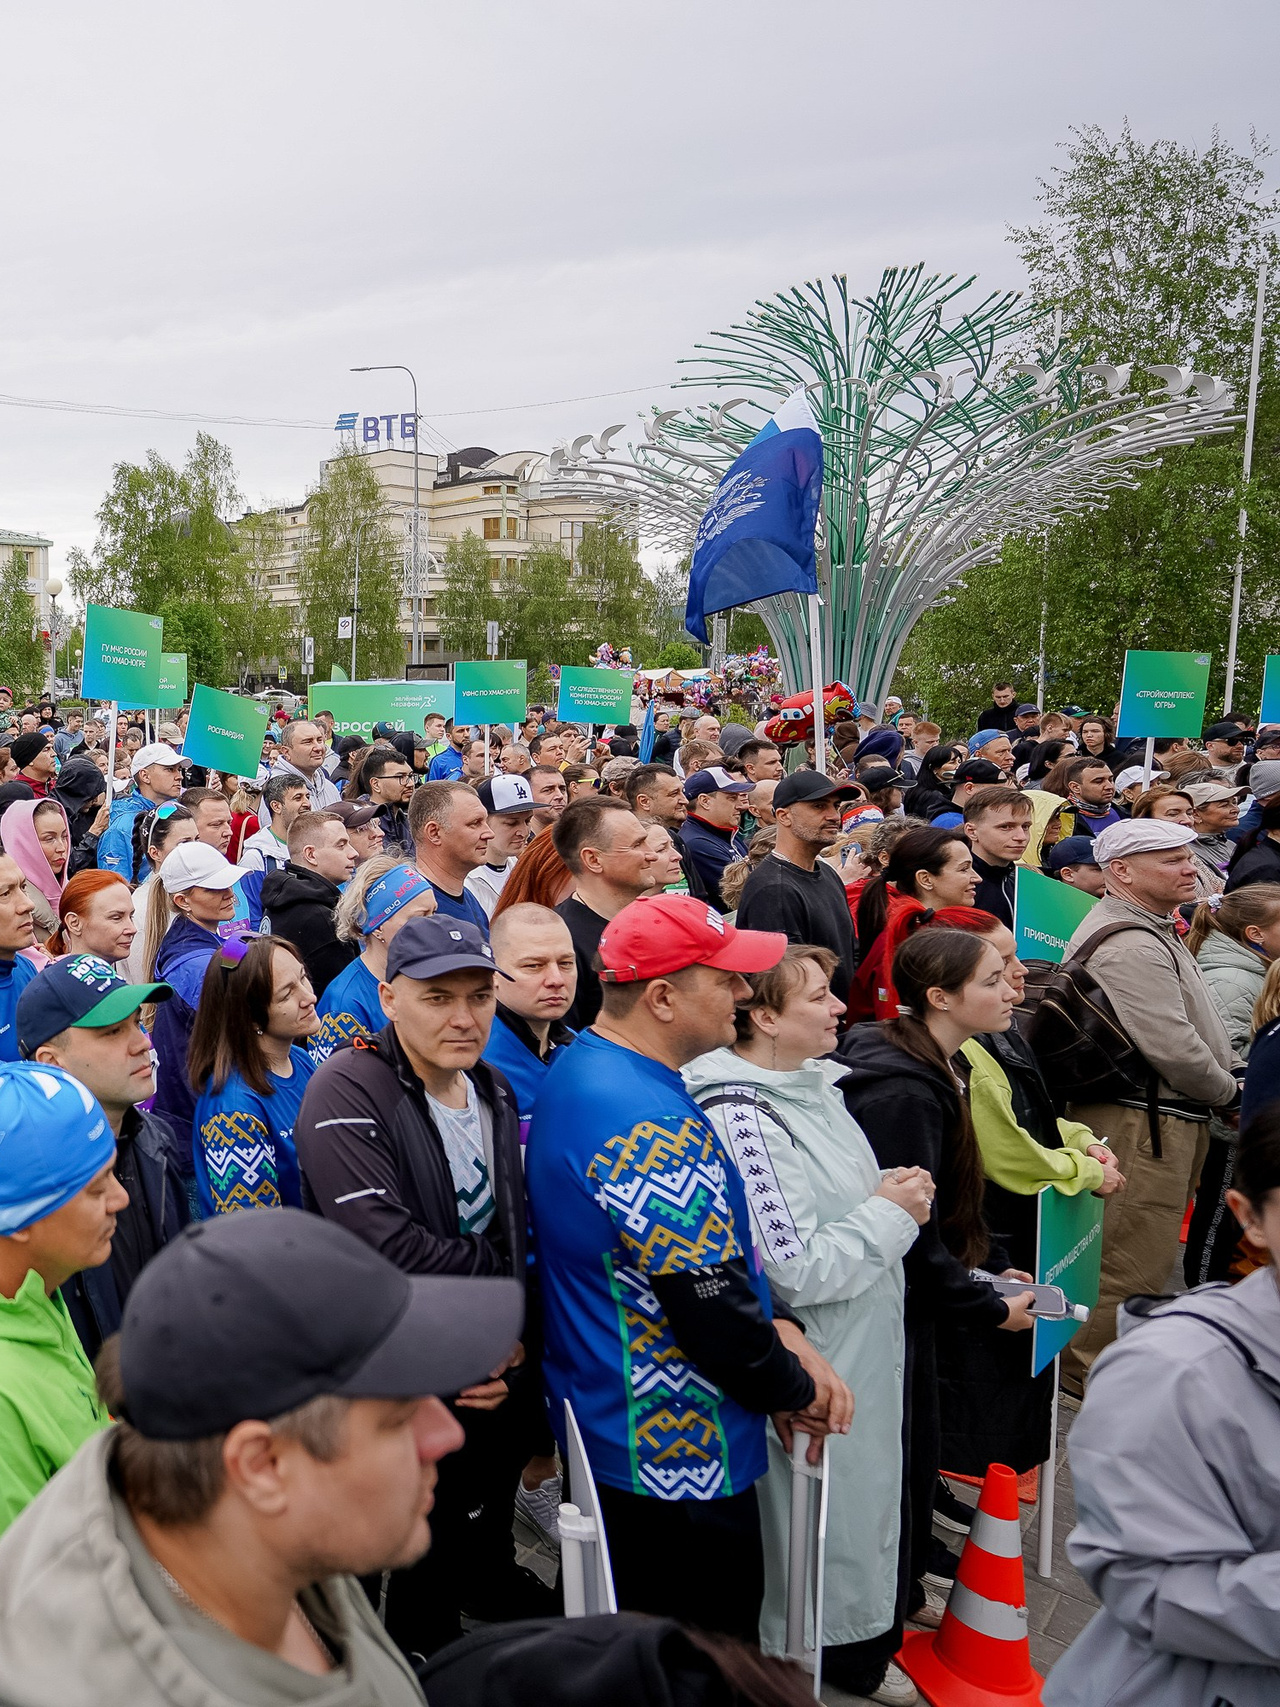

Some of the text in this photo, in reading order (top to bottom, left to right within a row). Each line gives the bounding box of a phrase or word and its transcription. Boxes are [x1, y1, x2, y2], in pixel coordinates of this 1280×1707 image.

[363, 413, 417, 442] ВТБ
[101, 643, 148, 657] ГУ МЧС РОССИИ
[101, 654, 146, 668] ПО ХМАО-ЮГРЕ
[1136, 690, 1195, 699] «СТРОЙКОМПЛЕКС
[1154, 701, 1176, 709] ЮГРЫ»
[207, 724, 244, 741] РОСГВАРДИЯ
[332, 719, 406, 732] ЗРОСЙ
[513, 782, 527, 799] LA
